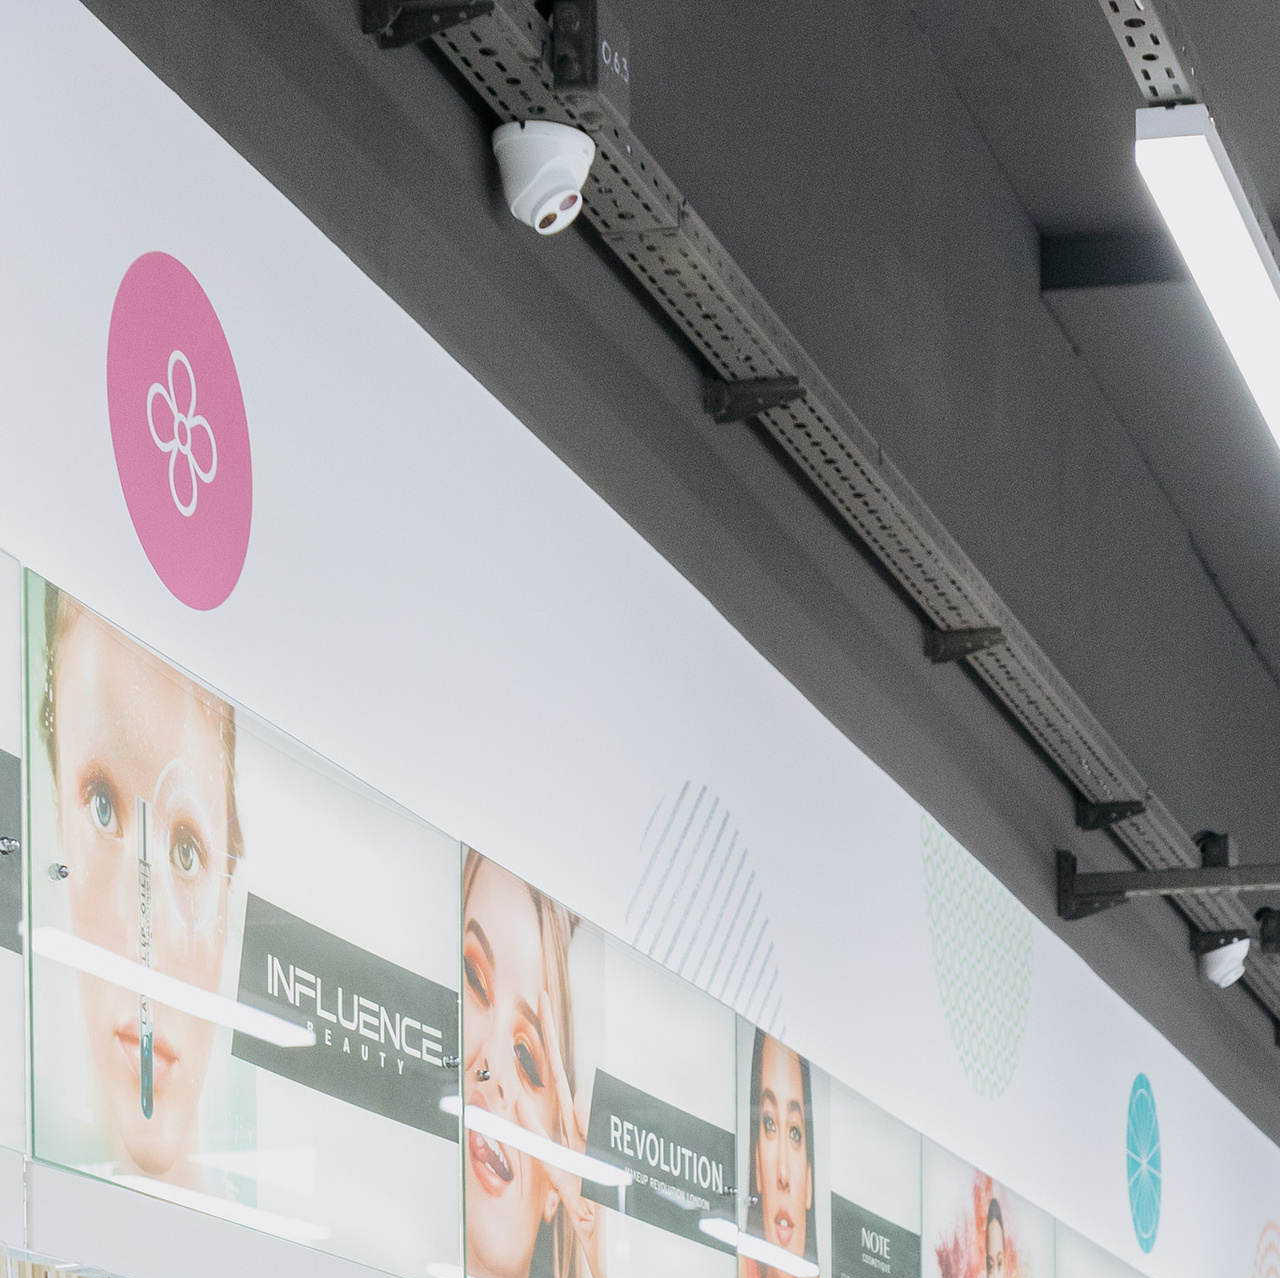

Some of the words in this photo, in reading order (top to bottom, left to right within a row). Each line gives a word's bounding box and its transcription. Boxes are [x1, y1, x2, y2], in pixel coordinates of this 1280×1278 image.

[267, 954, 442, 1067] INFLUENCE
[610, 1114, 723, 1194] REVOLUTION
[861, 1227, 890, 1259] NOTE
